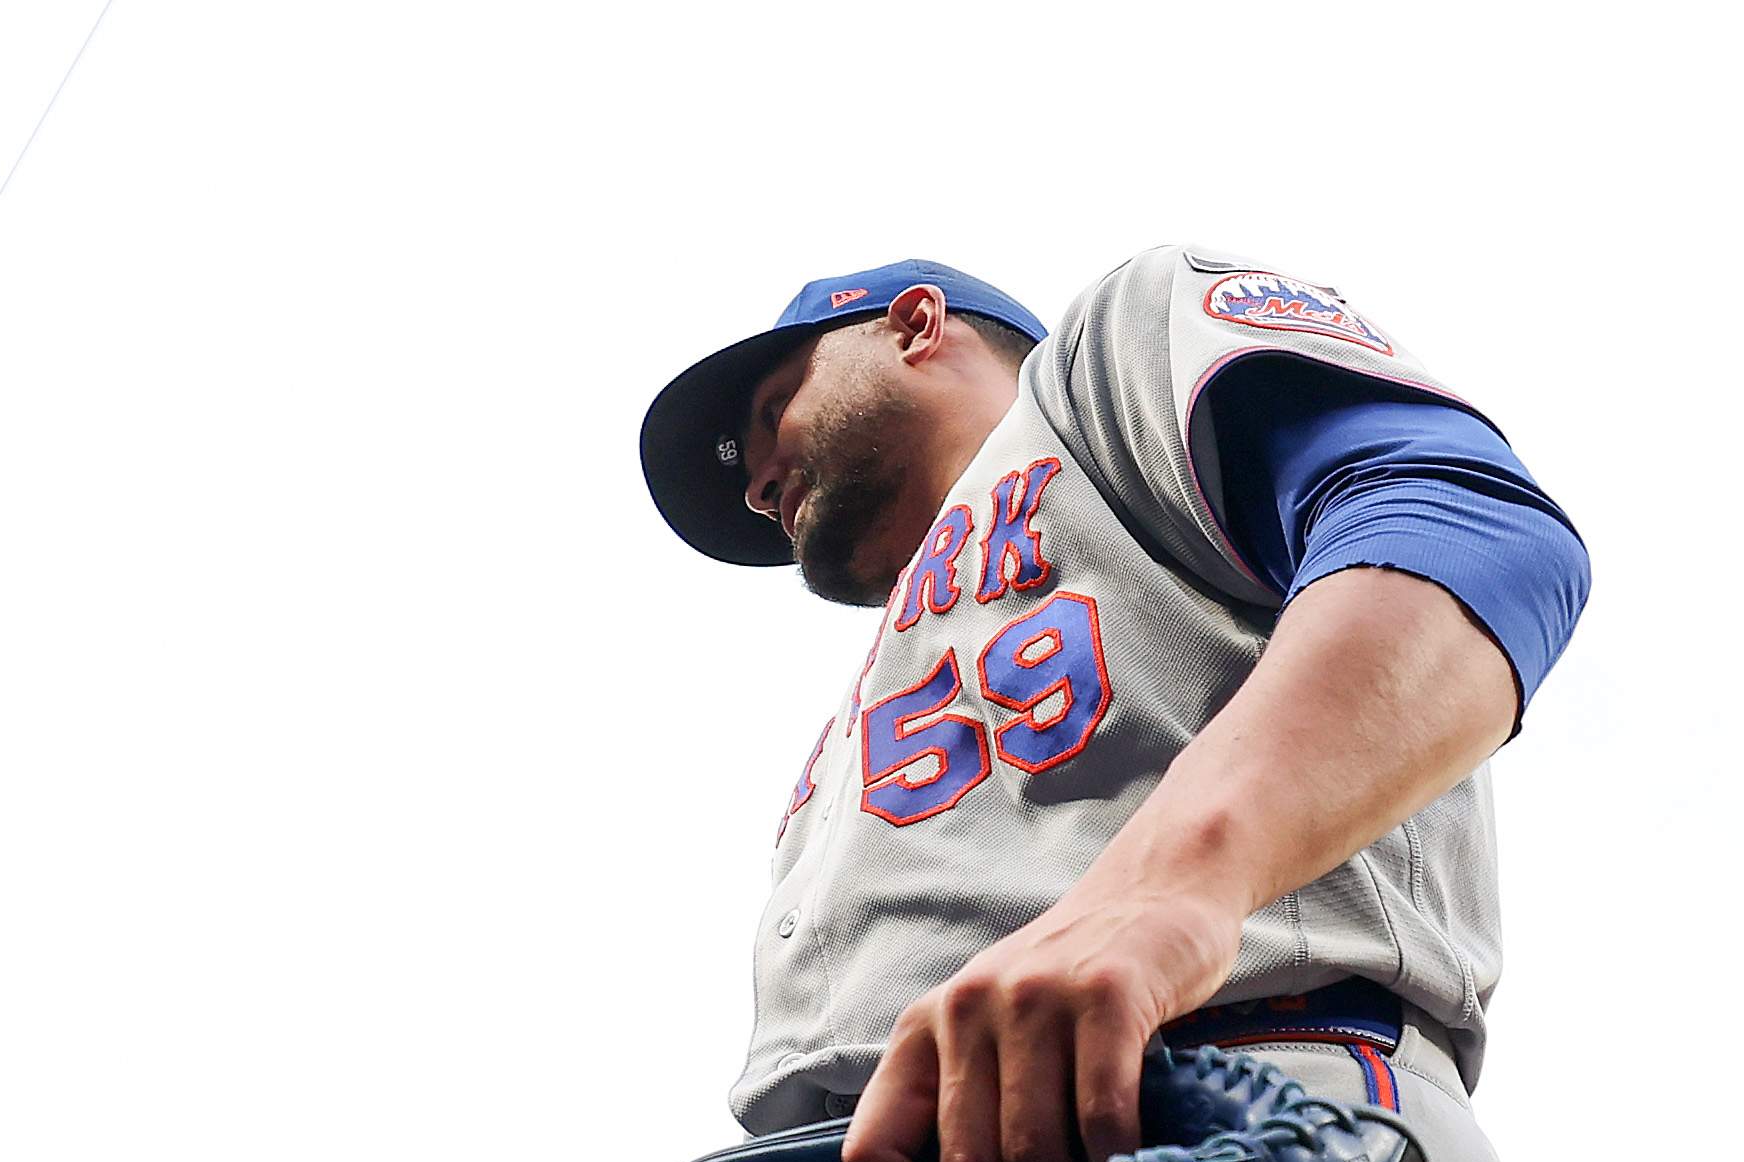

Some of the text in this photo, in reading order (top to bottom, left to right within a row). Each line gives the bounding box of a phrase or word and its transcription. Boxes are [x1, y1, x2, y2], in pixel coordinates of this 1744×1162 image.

[718, 439, 737, 461] 59
[856, 457, 1062, 690] RK
[860, 590, 1113, 828] 59
